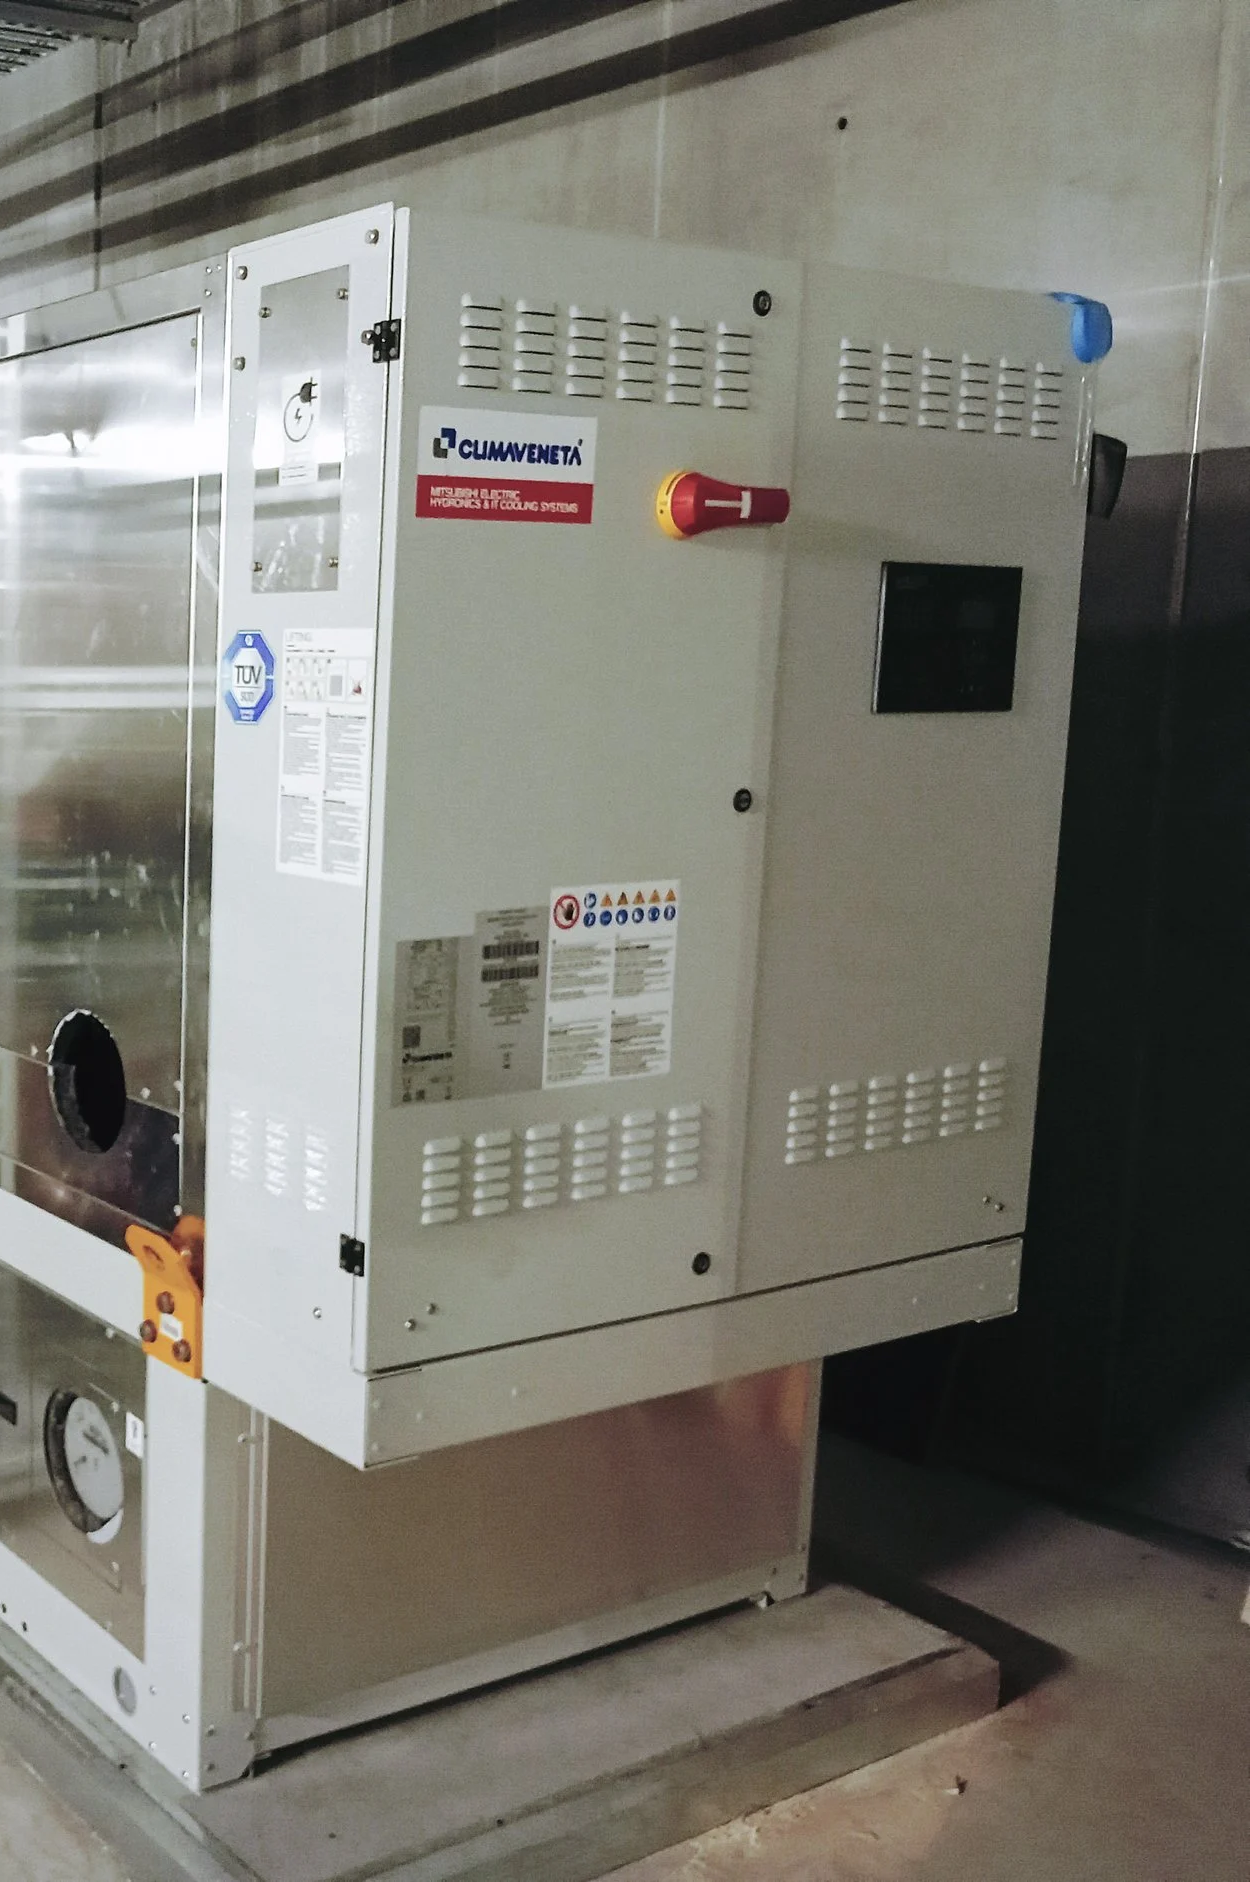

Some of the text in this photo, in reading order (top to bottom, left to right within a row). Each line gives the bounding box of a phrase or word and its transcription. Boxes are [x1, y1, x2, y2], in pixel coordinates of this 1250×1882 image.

[480, 488, 520, 500] ELECTRIC
[430, 497, 481, 509] HYDRONICS
[483, 499, 490, 509] &
[500, 500, 539, 511] COOLING
[540, 501, 579, 514] SYSTEMS
